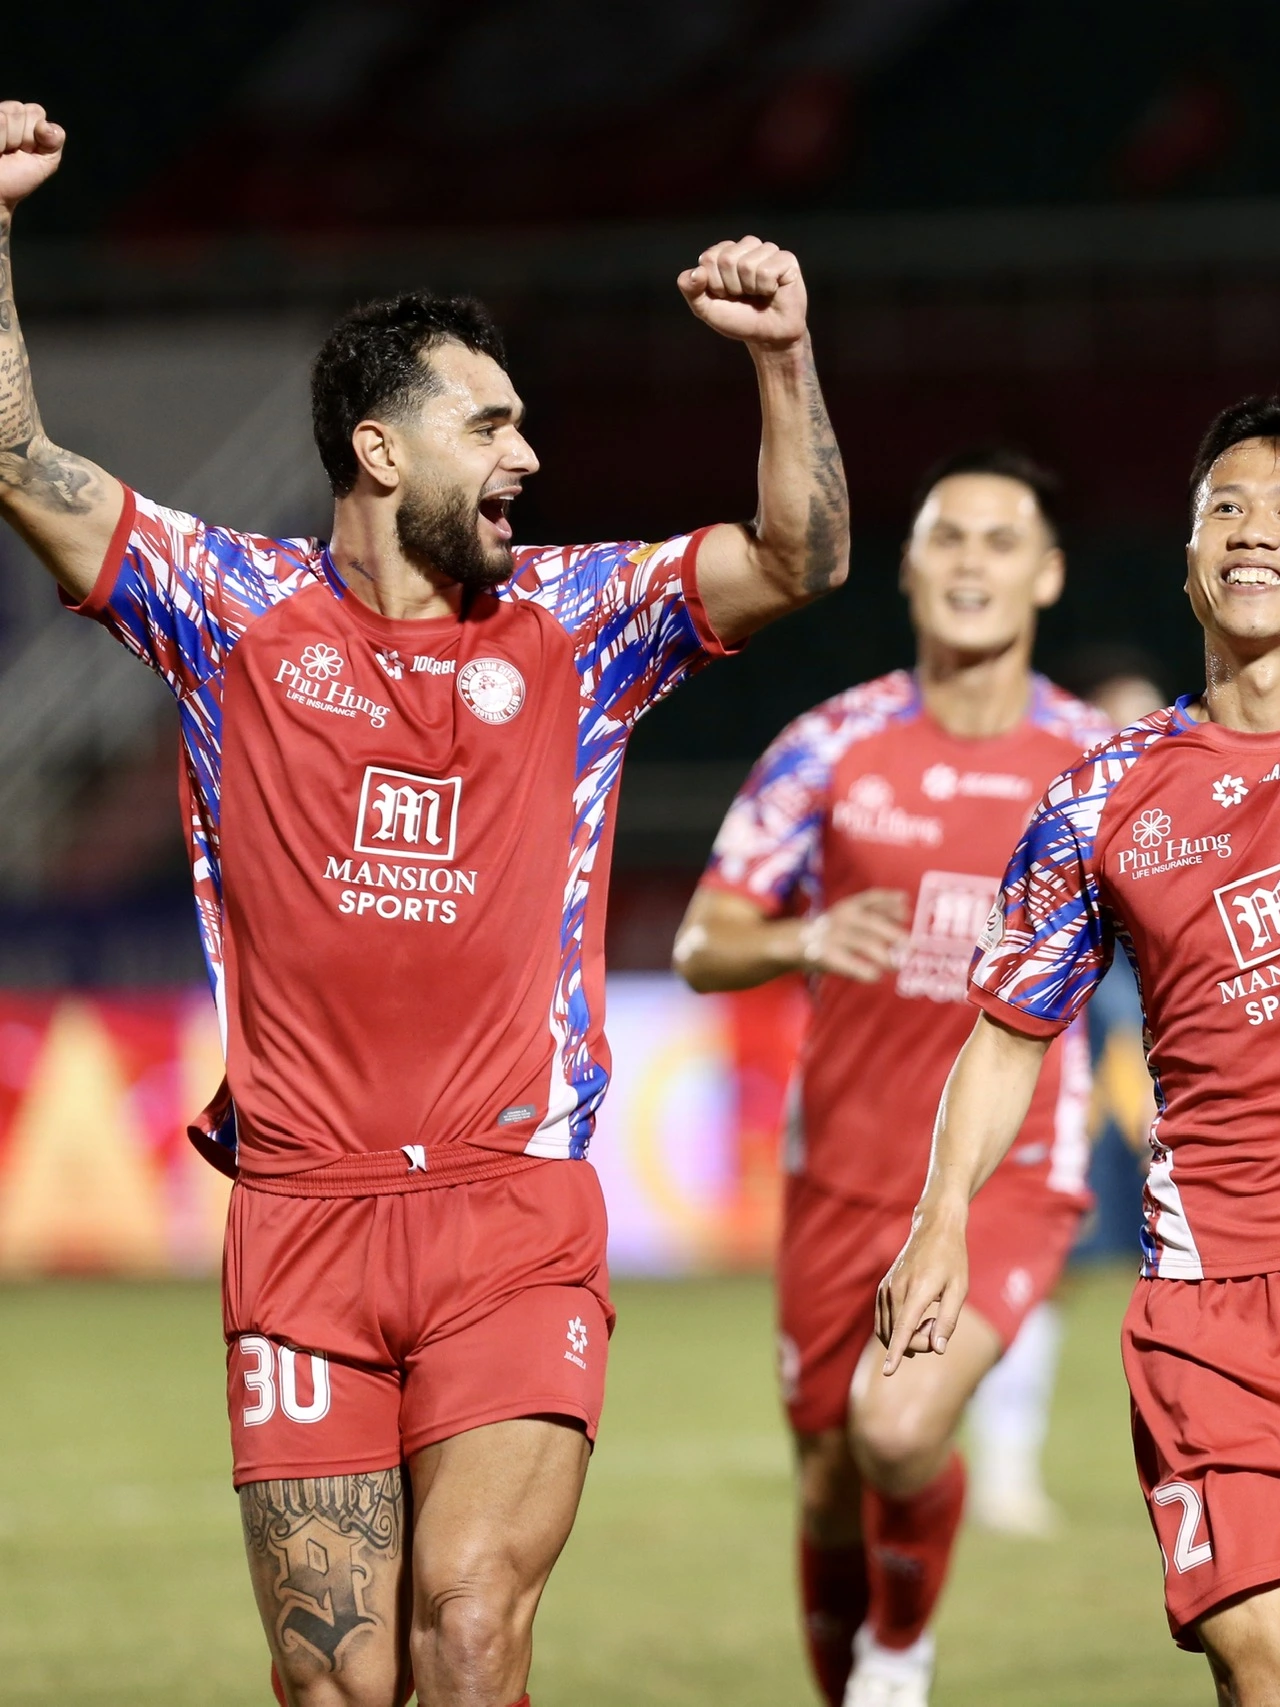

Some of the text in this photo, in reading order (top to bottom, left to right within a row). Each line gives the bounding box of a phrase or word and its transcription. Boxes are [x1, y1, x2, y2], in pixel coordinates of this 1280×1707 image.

[273, 658, 391, 729] Phu Hung
[285, 689, 358, 719] LIFE INSURANCE
[371, 783, 444, 847] M
[1117, 832, 1233, 875] Phu Hung
[1131, 855, 1203, 880] LIFE INSURANCE
[322, 855, 478, 896] MANSION
[338, 889, 458, 925] SPORTS
[239, 1333, 332, 1427] 30
[1153, 1482, 1214, 1575] 2
